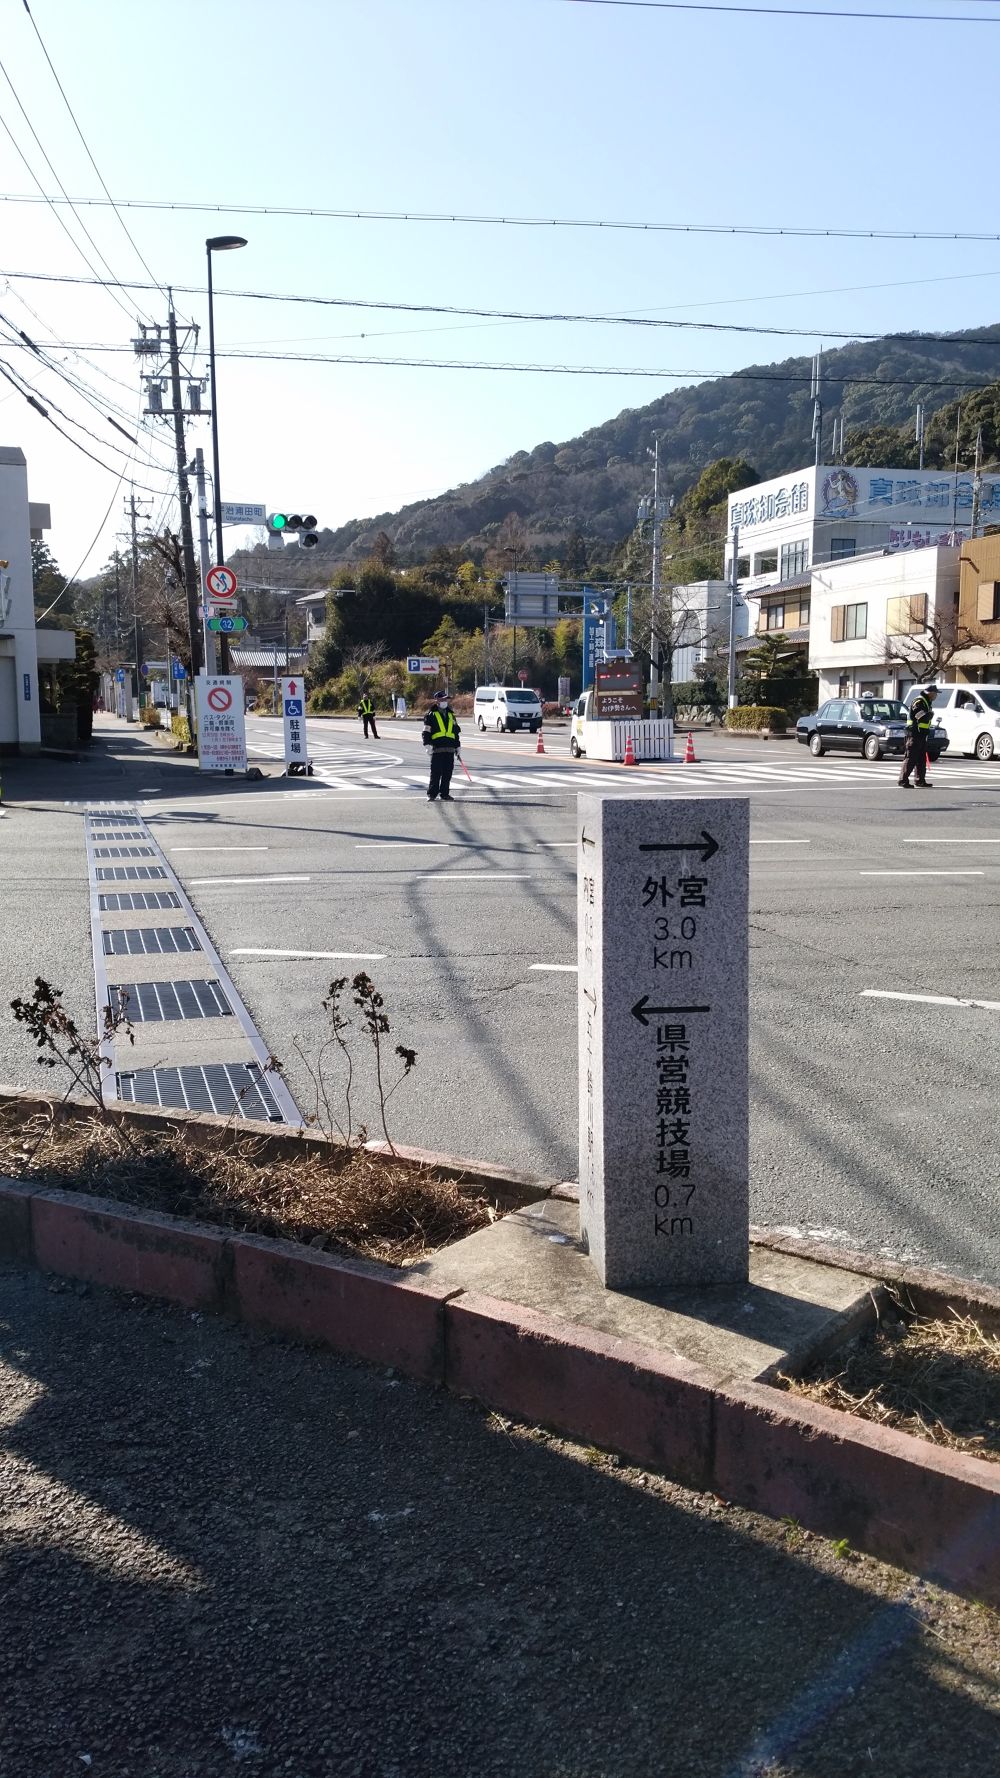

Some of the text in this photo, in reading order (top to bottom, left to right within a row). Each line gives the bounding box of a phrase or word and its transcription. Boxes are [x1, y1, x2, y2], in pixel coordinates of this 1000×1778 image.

[731, 482, 809, 531] 真珠卸会館
[222, 620, 232, 629] 32
[410, 660, 418, 671] P
[601, 704, 637, 713] お伊勢さんへ
[289, 719, 301, 754] 駐車場
[642, 875, 708, 908] 外宮
[654, 916, 696, 941] 3.0
[653, 946, 692, 969] km
[656, 1024, 691, 1179] 県営競技場
[654, 1184, 696, 1209] 0.7
[654, 1213, 693, 1236] km
